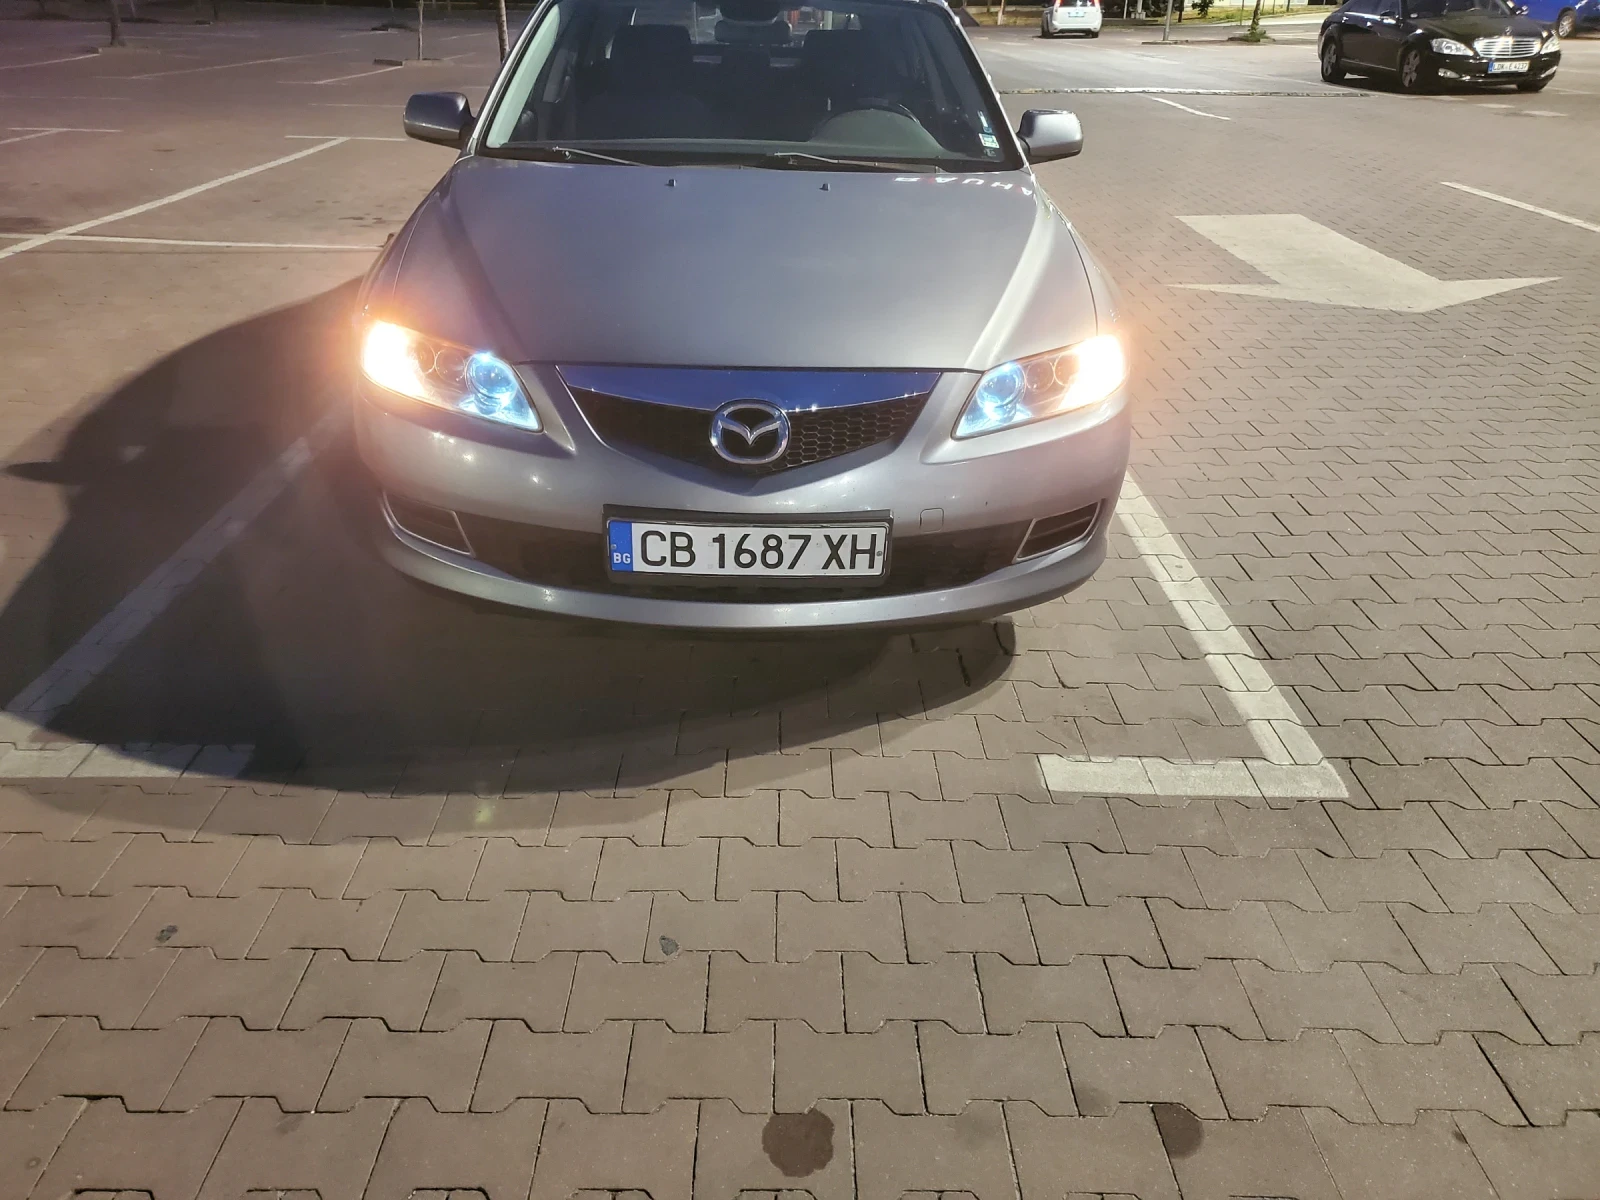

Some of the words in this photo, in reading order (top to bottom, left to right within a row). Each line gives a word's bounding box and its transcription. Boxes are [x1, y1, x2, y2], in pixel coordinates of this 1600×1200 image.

[613, 552, 631, 564] BG
[640, 530, 696, 568] CB
[712, 533, 812, 570] 1687
[821, 533, 877, 570] XH
